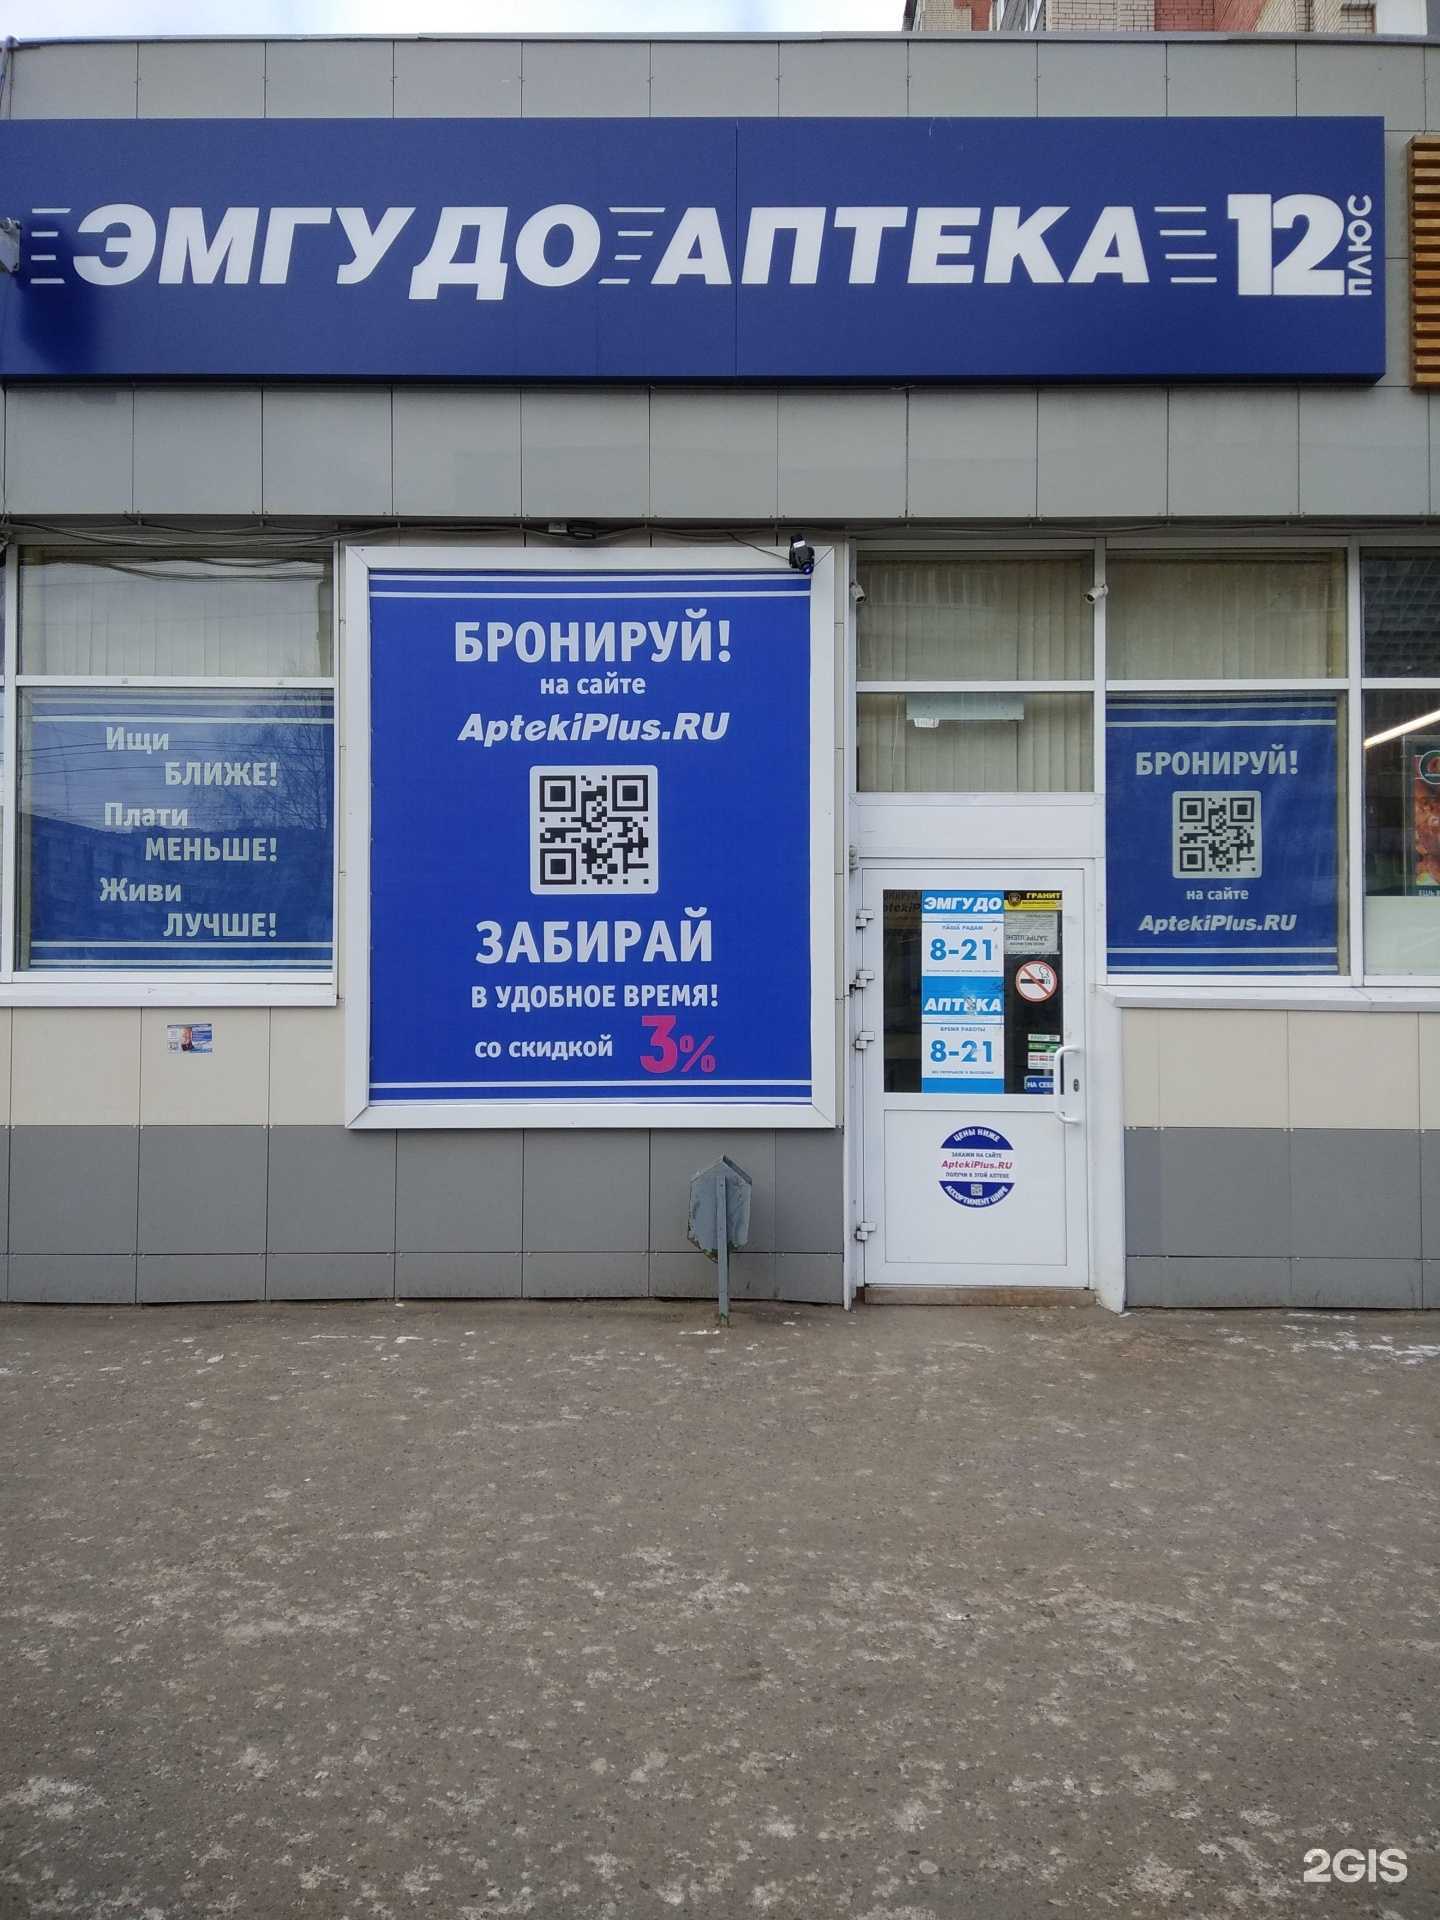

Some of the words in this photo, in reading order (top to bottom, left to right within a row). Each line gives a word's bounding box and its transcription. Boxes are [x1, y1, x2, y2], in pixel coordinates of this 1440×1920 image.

[73, 203, 601, 300] ЭМГУДО
[650, 206, 1150, 285] АПТЕКА
[1227, 193, 1345, 296] 12
[1347, 194, 1373, 296] ПЛЮС
[454, 608, 732, 663] БРОНИРУЙ!
[540, 676, 569, 694] на
[576, 671, 646, 694] сайте
[106, 726, 169, 754] Ищи
[457, 711, 730, 747] AptekiPlus.RU
[1135, 743, 1299, 775] БРОНИРУЙ!
[165, 761, 278, 786] БЛИЖЕ!
[104, 803, 188, 827] Плати
[145, 837, 278, 862] МЕНЬШЕ!
[99, 877, 182, 902] Живи
[1186, 888, 1204, 901] на
[1207, 886, 1249, 901] сайте
[923, 896, 1002, 913] ЭМГУДО
[163, 912, 278, 937] ЛУЧШЕ!
[475, 906, 712, 964] ЗАБИРАЙ
[1138, 914, 1297, 934] AptekiPlus.RU
[930, 938, 992, 961] 8-21
[471, 986, 486, 1008] В
[496, 986, 616, 1012] УДОБНОЕ
[624, 984, 719, 1007] ВРЕМЯ!
[923, 997, 1002, 1012] АПТЕКА
[474, 1042, 501, 1057] со
[508, 1035, 613, 1060] скидкой
[640, 1015, 716, 1074] 3%
[930, 1039, 992, 1063] 8-21
[942, 1160, 1012, 1169] AptekiPlus.RU
